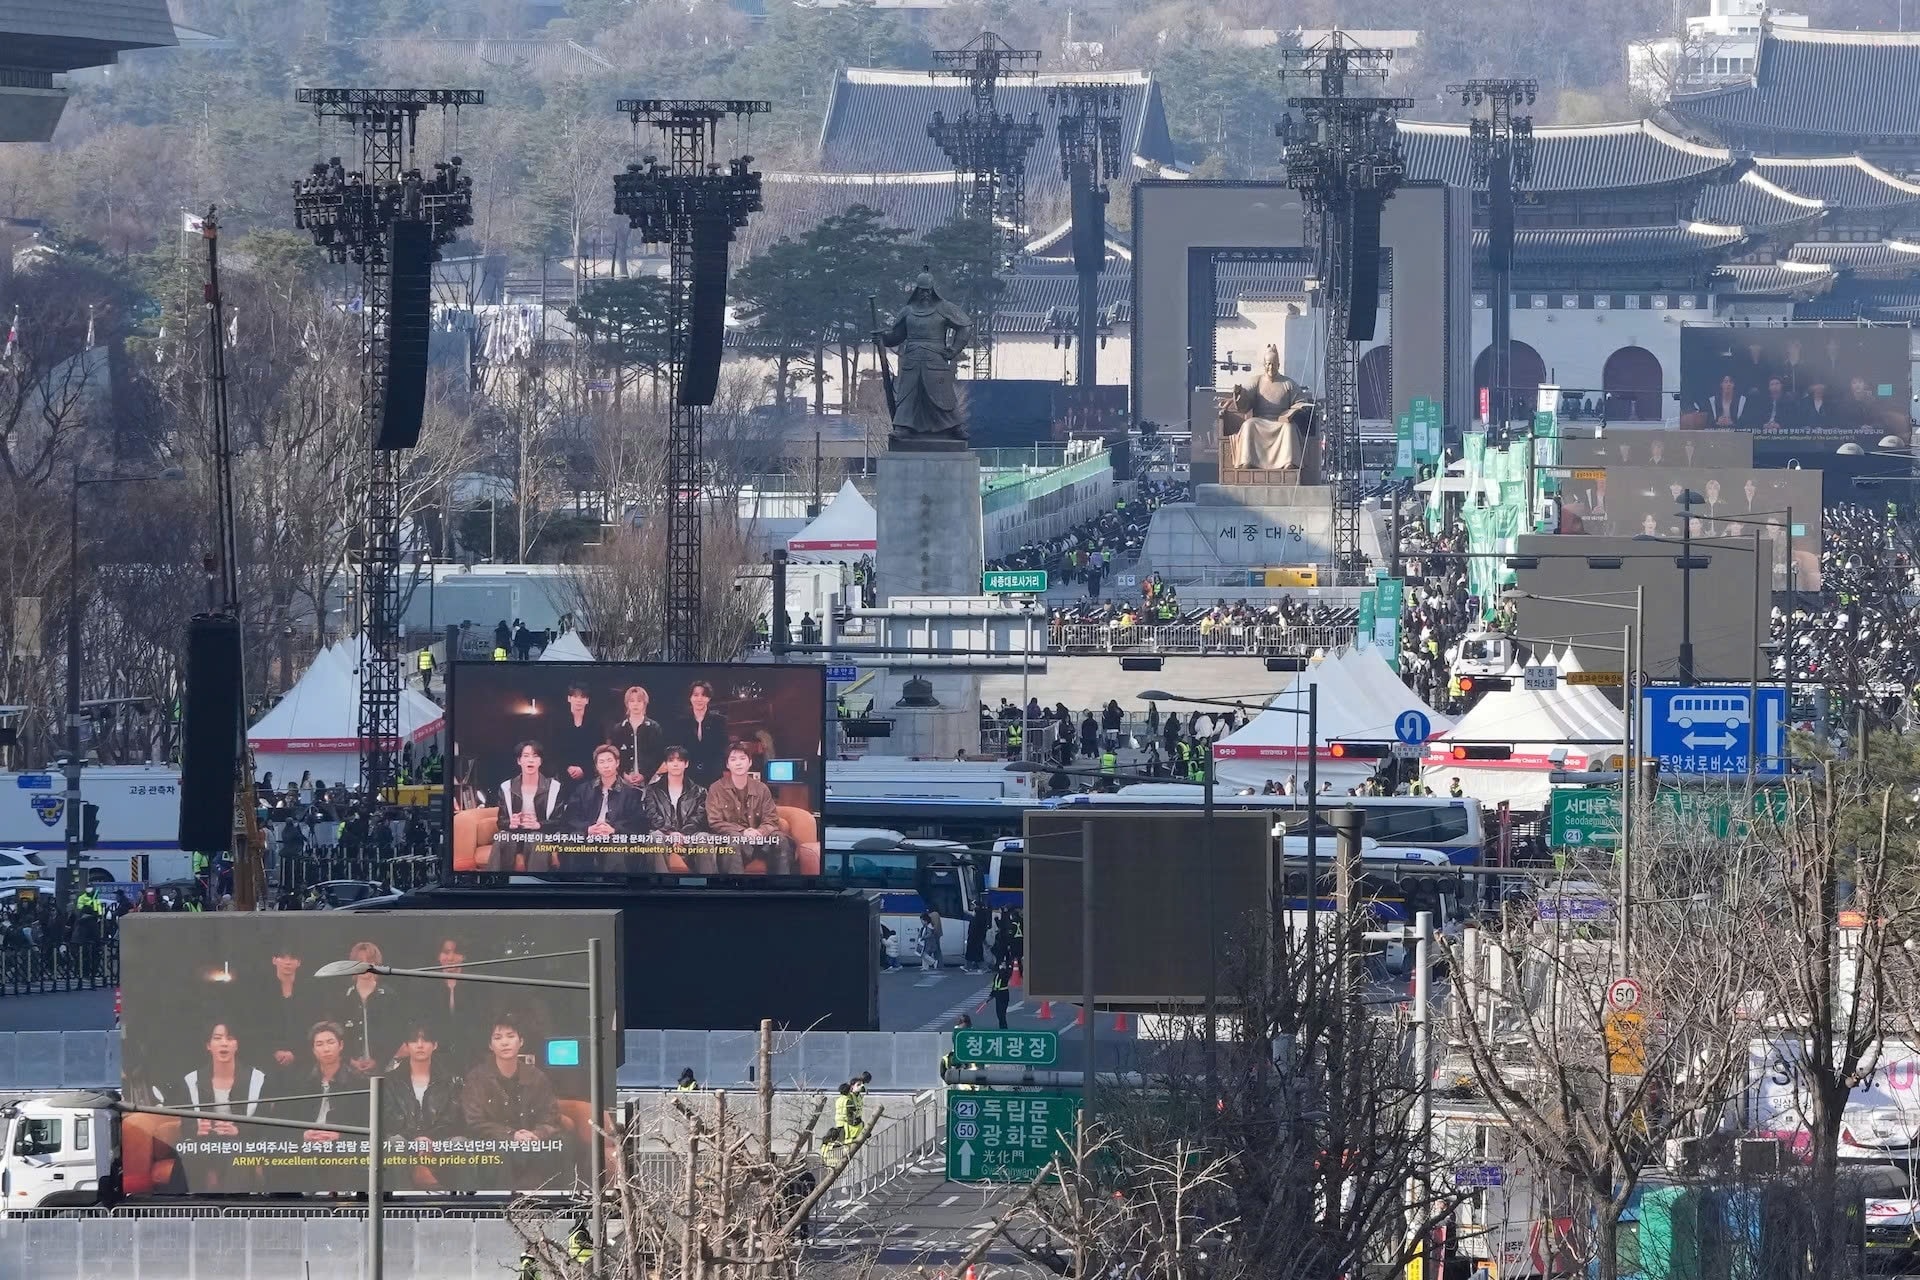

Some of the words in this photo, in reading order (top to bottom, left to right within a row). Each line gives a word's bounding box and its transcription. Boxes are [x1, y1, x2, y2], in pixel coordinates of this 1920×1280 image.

[1219, 524, 1305, 542] 세종대왕
[988, 574, 1040, 588] 세종대로사거리
[1659, 754, 1759, 772] 중앙차로버스전
[129, 785, 147, 795] 고공
[148, 785, 175, 795] 관측차
[493, 833, 510, 843] 아미
[511, 833, 543, 843] 여러분이
[544, 833, 585, 843] 보여주시는
[612, 834, 628, 843] 관람
[683, 835, 730, 844] 방탄소년단의
[731, 835, 780, 845] 자부심입니다
[1567, 831, 1579, 840] 21
[535, 844, 563, 853] ARMY's
[564, 845, 598, 853] excellent
[599, 845, 628, 853] concert
[629, 845, 665, 855] etiquette
[688, 846, 709, 855] pride
[1615, 987, 1635, 1002] 50
[966, 1036, 1047, 1058] 청계광장
[959, 1104, 975, 1115] 21
[982, 1100, 1050, 1124] 독립문
[959, 1125, 974, 1136] 50
[981, 1124, 1049, 1148] 광화문
[176, 1142, 197, 1154] 아미
[200, 1141, 242, 1154] 여러분이
[246, 1141, 298, 1153] 보여주시는
[301, 1141, 333, 1153] 성숙한
[336, 1140, 357, 1153] 관람
[360, 1140, 392, 1153] 문가
[395, 1140, 405, 1152] 곧
[408, 1140, 430, 1152] 저희
[432, 1140, 496, 1152] 방탄소년단의
[498, 1139, 563, 1152] 자부심입니다
[232, 1156, 270, 1166] ARMY's
[271, 1156, 317, 1166] excellent
[319, 1156, 358, 1166] concert
[409, 1155, 418, 1165] is
[420, 1154, 438, 1165] the
[439, 1154, 466, 1167] pride
[468, 1154, 480, 1165] of
[481, 1155, 504, 1165] BTS.
[982, 1149, 1025, 1164] 光化門
